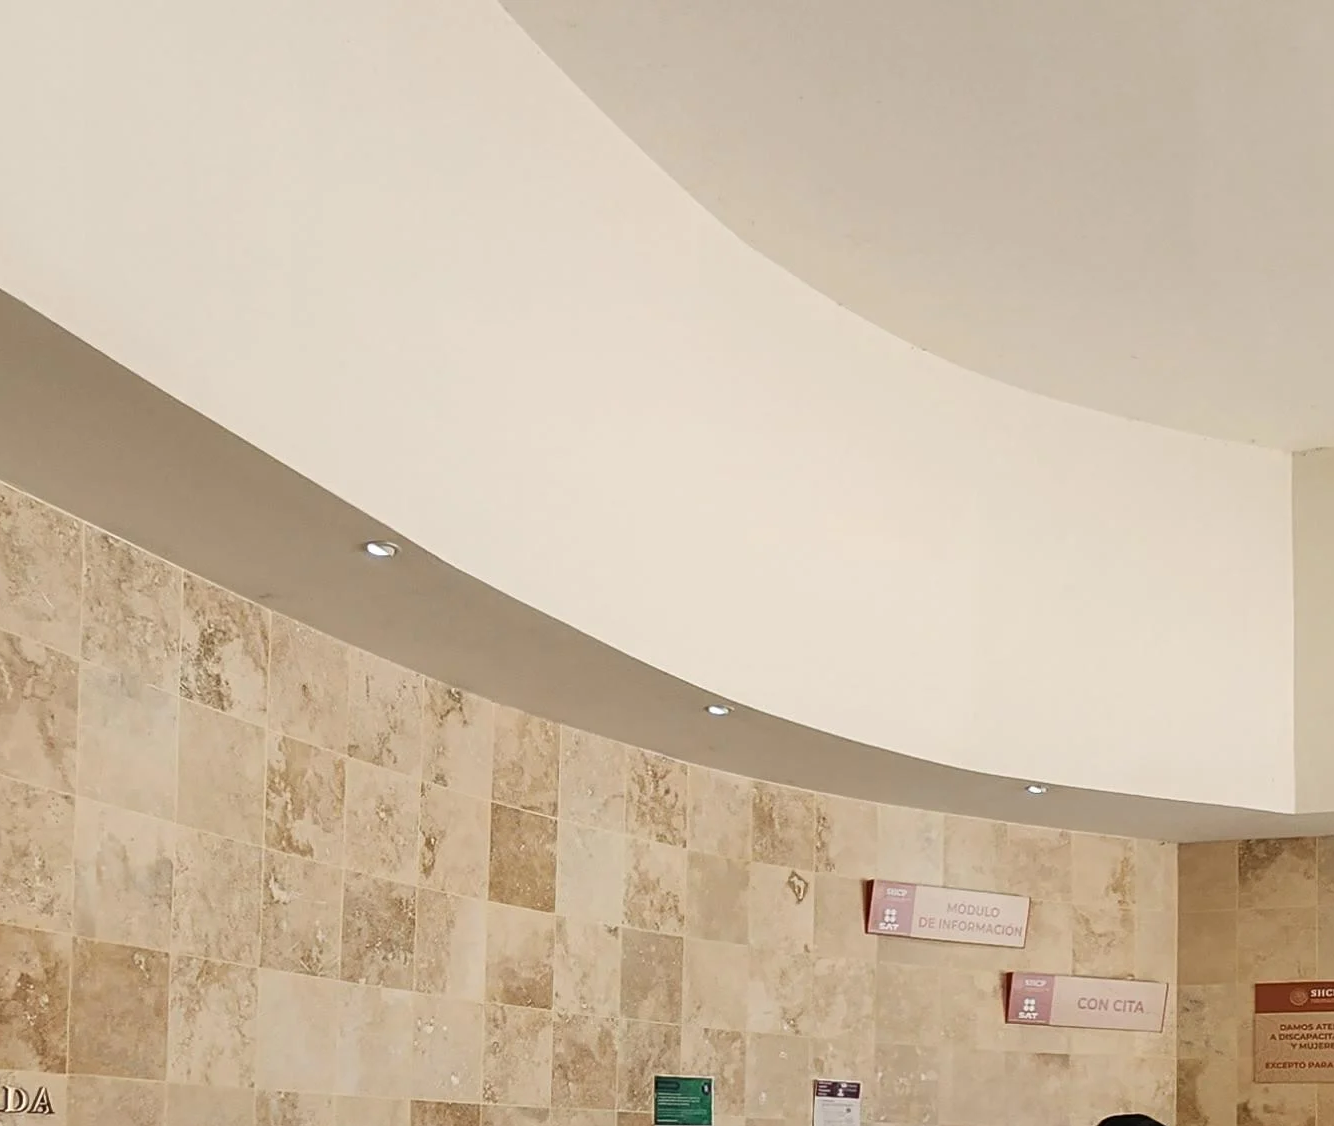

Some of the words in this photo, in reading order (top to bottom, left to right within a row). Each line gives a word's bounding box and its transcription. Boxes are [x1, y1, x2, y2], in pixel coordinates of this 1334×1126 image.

[878, 921, 899, 931] SAT
[918, 916, 936, 929] DE
[1077, 997, 1109, 1011] CON
[1113, 999, 1144, 1014] CITA
[1279, 1023, 1314, 1031] DAMOS
[1269, 1033, 1277, 1041] A
[1265, 1061, 1306, 1069] EXCEPTO
[1308, 1061, 1334, 1069] PARA
